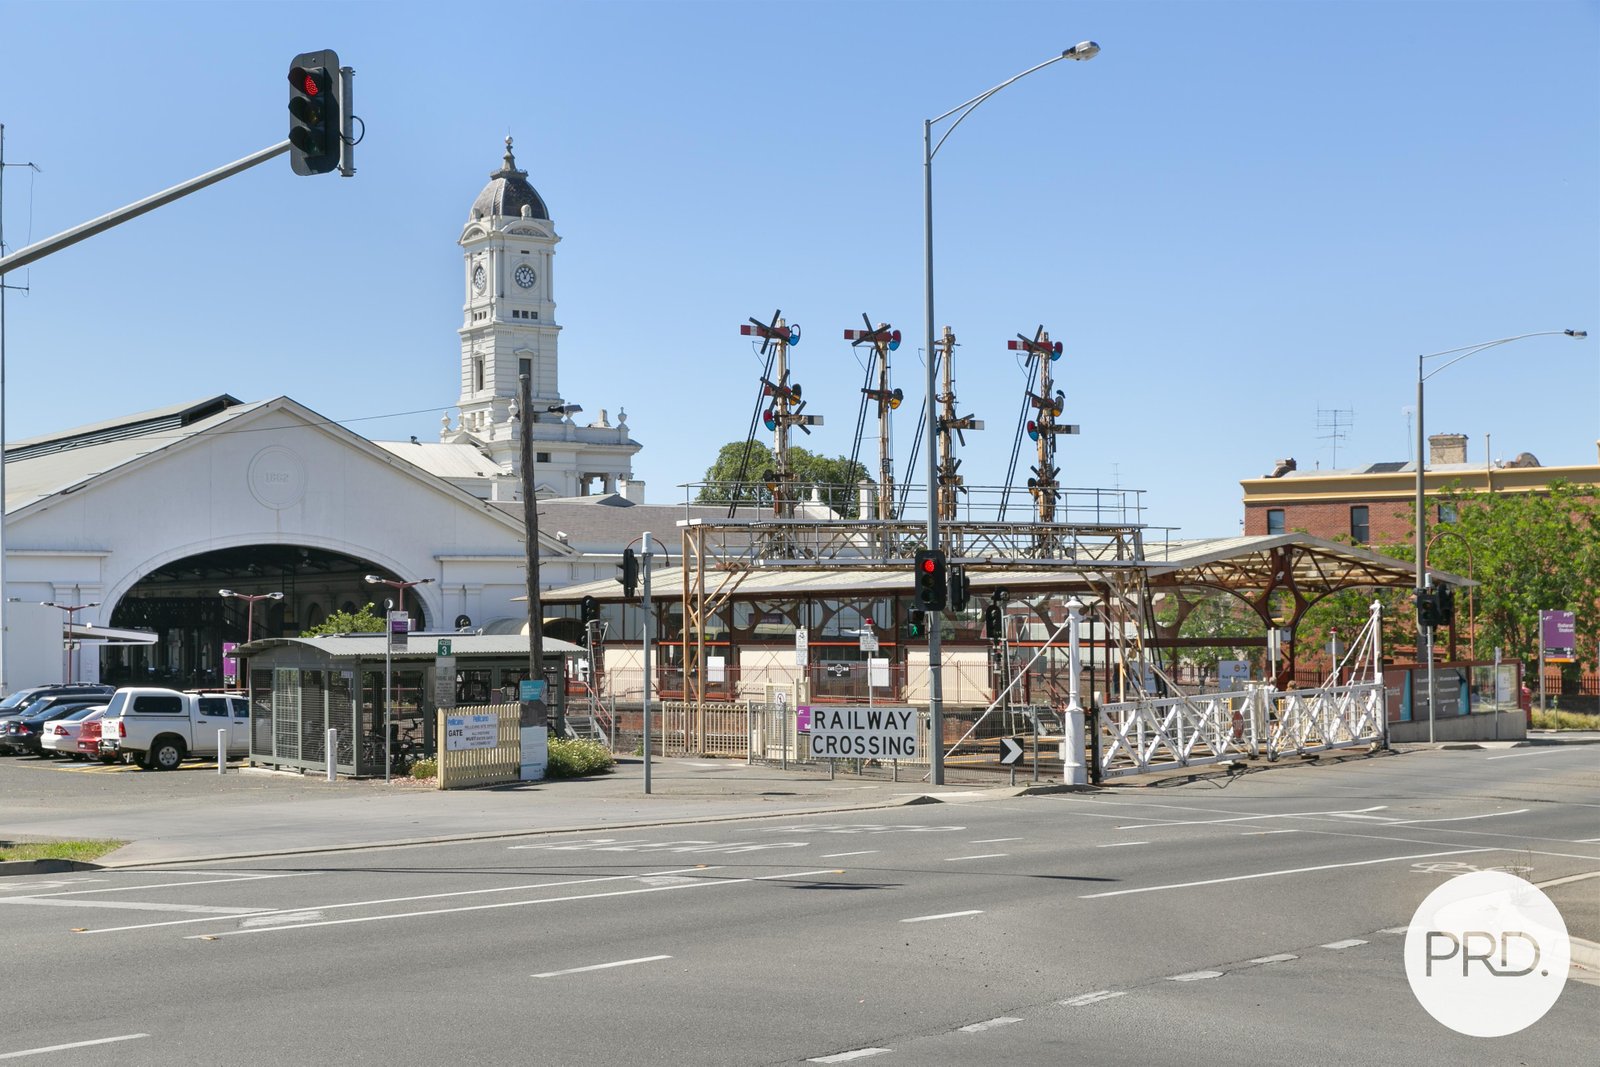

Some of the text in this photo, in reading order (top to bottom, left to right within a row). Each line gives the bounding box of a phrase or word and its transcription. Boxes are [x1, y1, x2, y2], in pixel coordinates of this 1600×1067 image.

[441, 646, 447, 655] 3
[814, 711, 912, 730] RAILWAY
[813, 735, 915, 755] CROSSING
[507, 838, 810, 853] CLEAR
